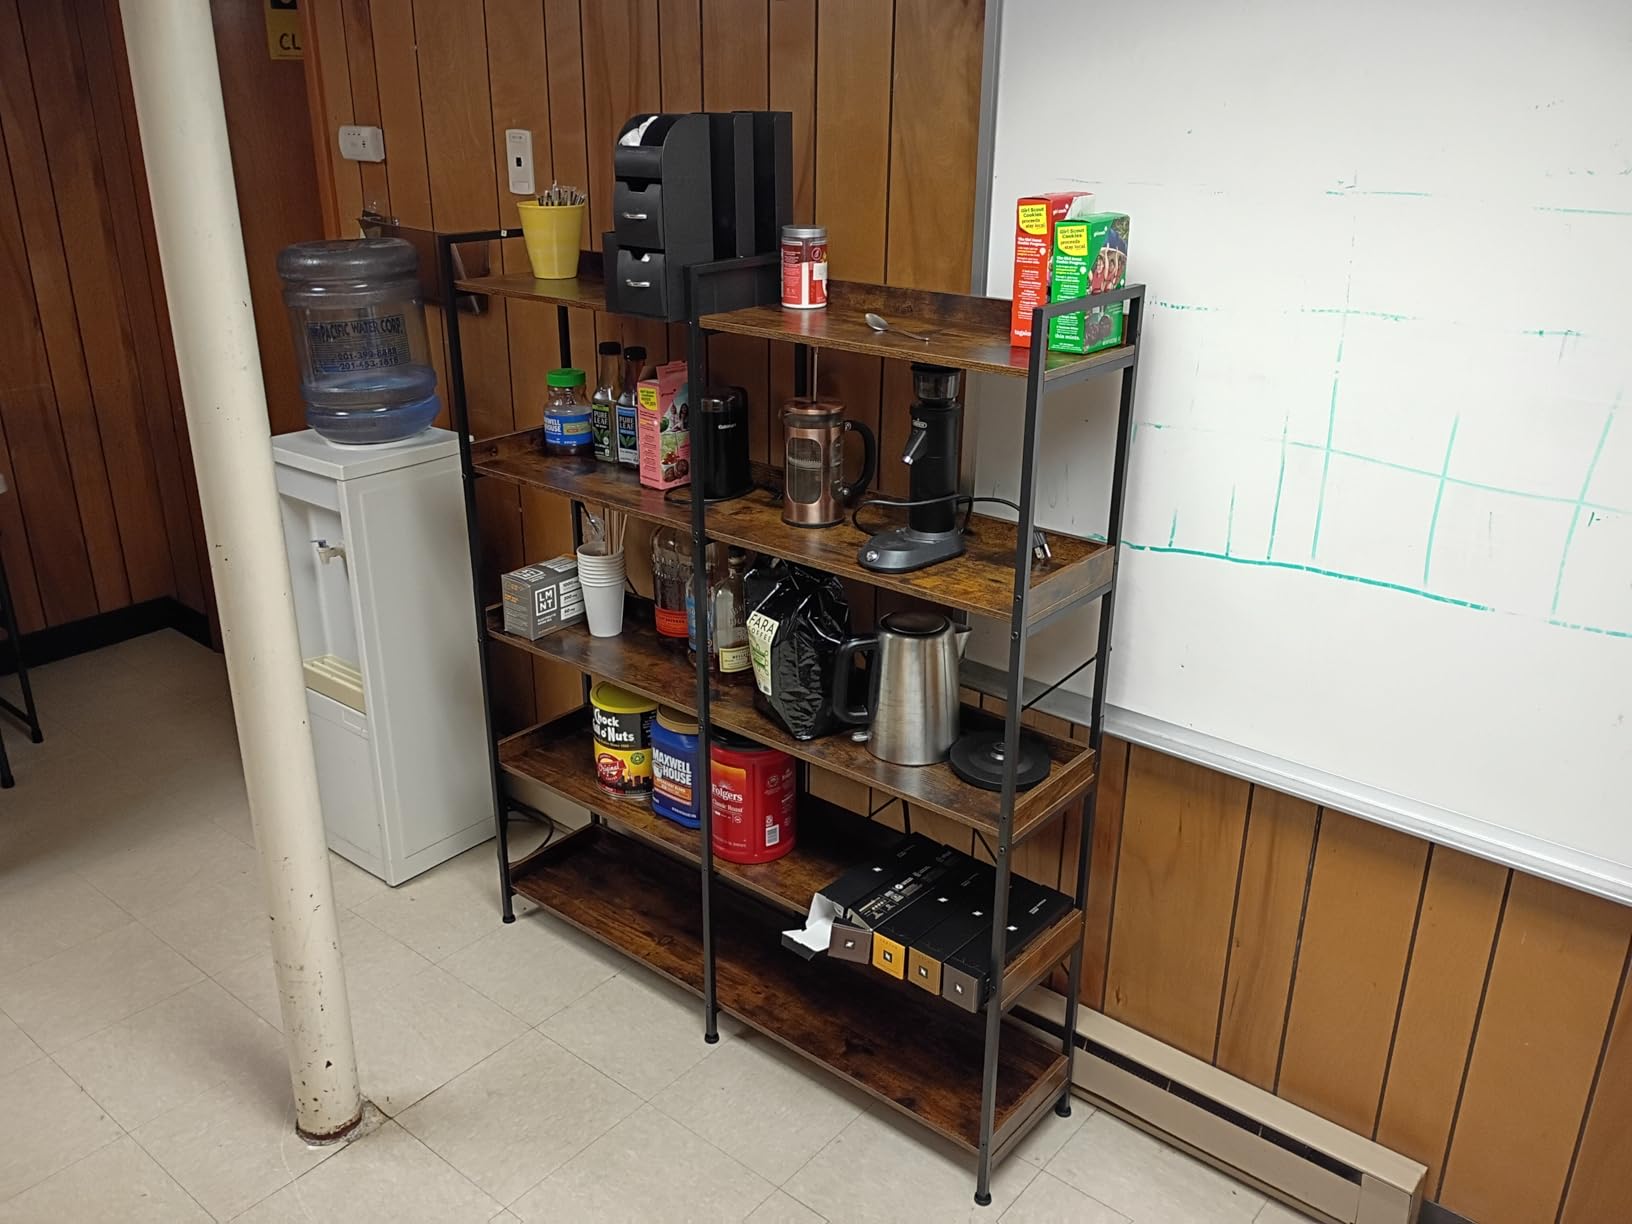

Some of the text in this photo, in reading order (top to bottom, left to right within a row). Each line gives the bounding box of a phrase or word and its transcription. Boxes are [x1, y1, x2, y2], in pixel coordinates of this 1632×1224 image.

[320, 323, 350, 343] PACIFIC
[350, 320, 380, 337] WATER
[593, 410, 608, 419] PURE
[593, 417, 608, 426] LEAF
[619, 416, 634, 424] PURE
[619, 422, 634, 431] LEAF
[749, 613, 774, 636] FARA
[594, 708, 620, 728] Chock
[652, 747, 692, 775] MAXWELL
[662, 765, 692, 786] HOUSE
[711, 783, 744, 802] Folgers
